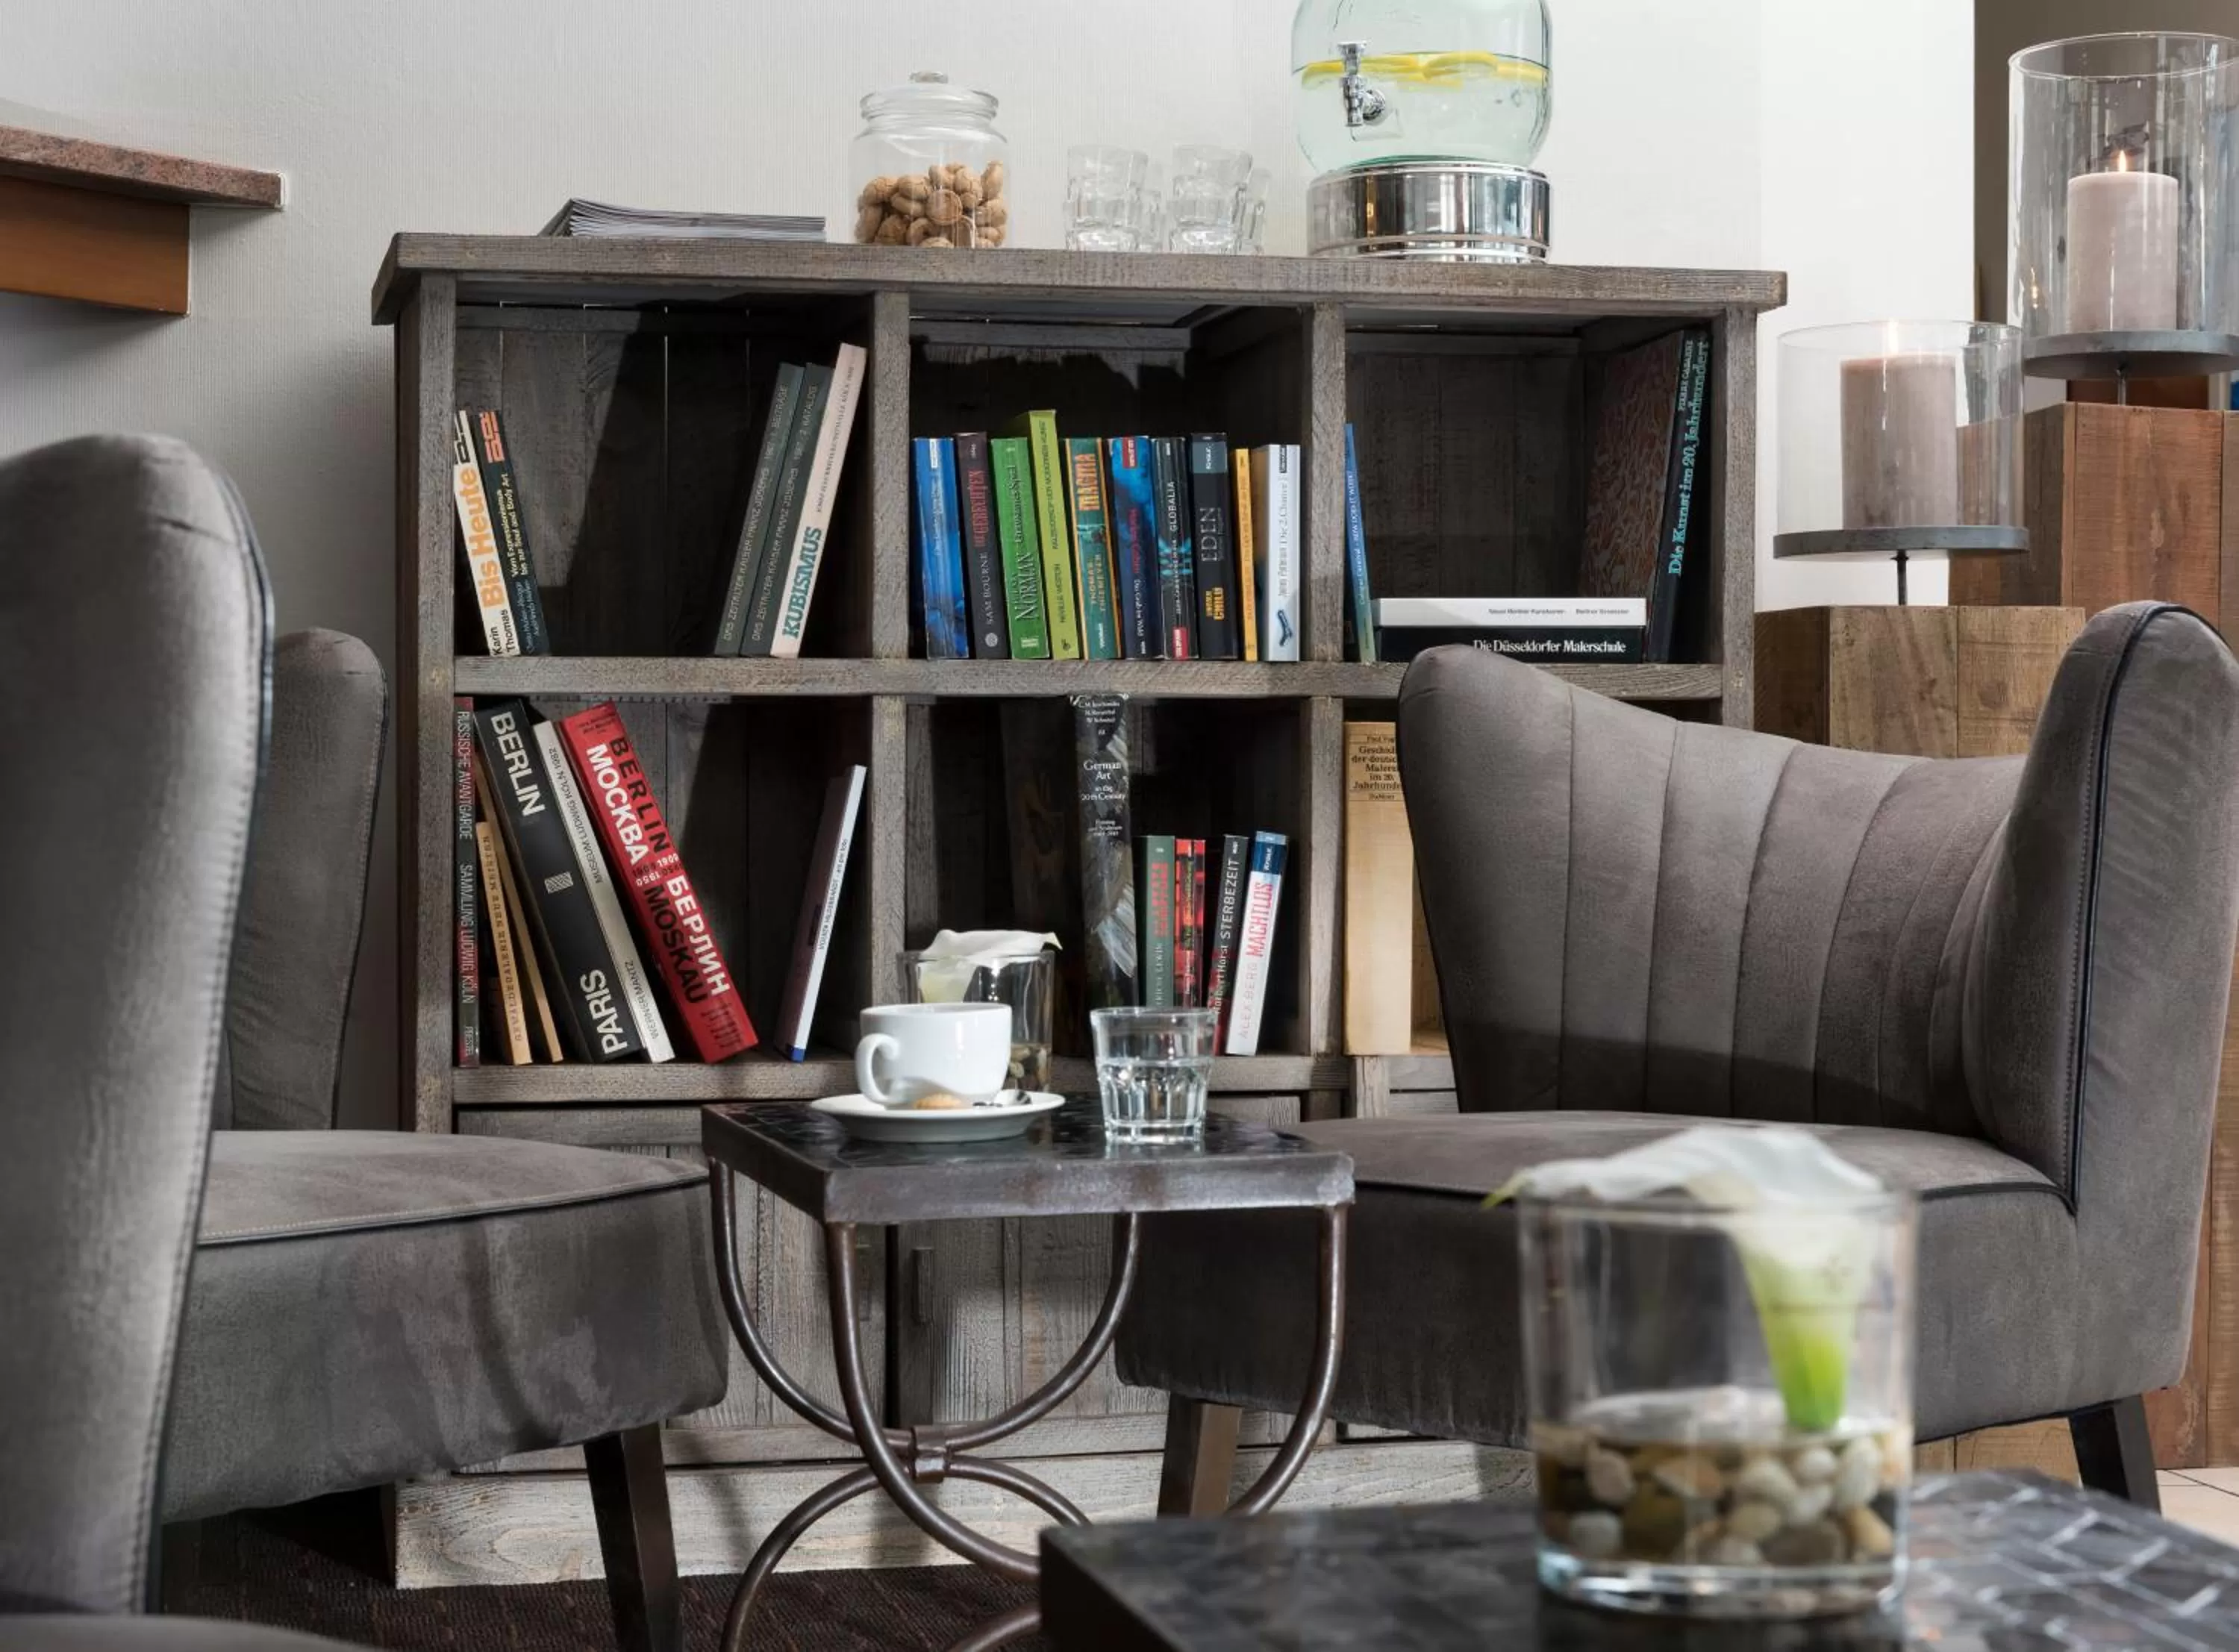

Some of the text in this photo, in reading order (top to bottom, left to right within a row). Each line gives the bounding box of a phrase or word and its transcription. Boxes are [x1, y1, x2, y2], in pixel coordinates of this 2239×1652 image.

[1075, 453, 1099, 512] MAGMA
[1669, 340, 1709, 575] Die Kunst im 20. Jahrhundert
[458, 466, 493, 556] Heute
[497, 489, 515, 557] Expressionismus
[506, 488, 515, 509] Body
[1169, 481, 1178, 531] GLOBALIA
[1200, 507, 1217, 562] EDEN
[478, 559, 504, 607] Bis
[783, 526, 822, 639] KUBISMUS
[981, 551, 992, 598] BOURNE
[1017, 550, 1038, 623] NORMAN
[1087, 557, 1097, 604] THOMAS
[1096, 553, 1106, 612] THIEMEYER
[1212, 587, 1224, 620] CHILD
[490, 626, 502, 655] Karin
[501, 609, 514, 652] Thomas
[1473, 639, 1626, 653] Die Düsseldorfer Malerschule
[456, 711, 472, 839] RUSSISCHE AVANTGARDE
[490, 709, 546, 819] BERLIN
[1084, 760, 1121, 770] German
[1096, 771, 1111, 780] Art
[1351, 780, 1400, 789] Jahrhunde
[1365, 763, 1397, 772] Malere
[1383, 772, 1394, 780] 20.
[549, 746, 603, 884] MUSEUM LUDWIG KÖLN 1982
[586, 744, 649, 864] МОСКВА
[609, 737, 666, 853] BERLIN
[1099, 792, 1125, 801] Century
[493, 893, 503, 927] NEUE
[1221, 858, 1239, 939] STERBEZEIT
[1246, 880, 1273, 957] MACHTLOS
[459, 864, 477, 1004] SAMMLUNG LUDWIG KÖLN
[643, 885, 710, 1004] MOSKAU
[667, 875, 731, 995] БЕРЛИН
[1219, 945, 1228, 972] Horst
[576, 967, 629, 1057] PARIS
[625, 959, 660, 1039] WERNER MANTZ
[1238, 960, 1258, 1039] ALEX BERG
